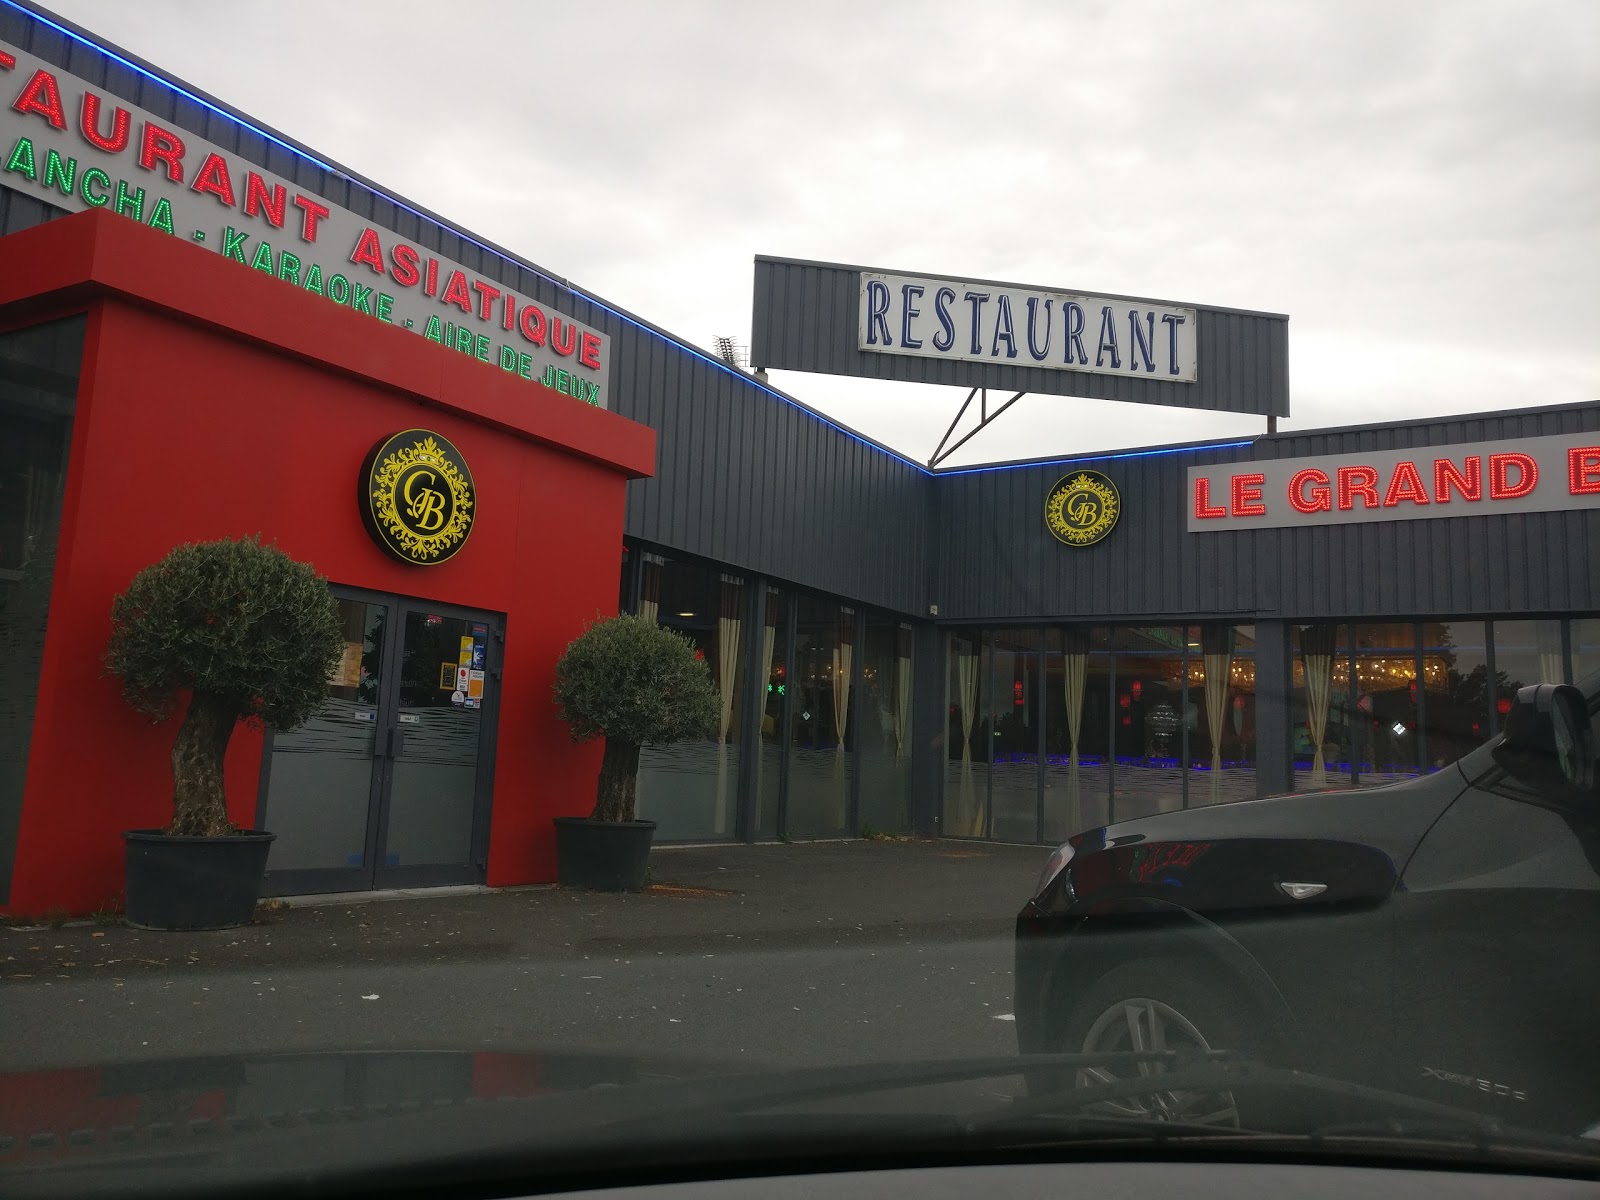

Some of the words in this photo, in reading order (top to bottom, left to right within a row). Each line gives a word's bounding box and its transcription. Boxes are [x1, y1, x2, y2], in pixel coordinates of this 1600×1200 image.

[222, 226, 394, 324] KARAOKE
[424, 315, 491, 362] AIRE
[499, 344, 533, 379] DE
[542, 365, 601, 408] JEUX
[350, 227, 602, 369] ASIATIQUE
[866, 280, 1186, 375] RESTAURANT
[1195, 473, 1266, 519] LE
[1288, 452, 1539, 513] GRAND
